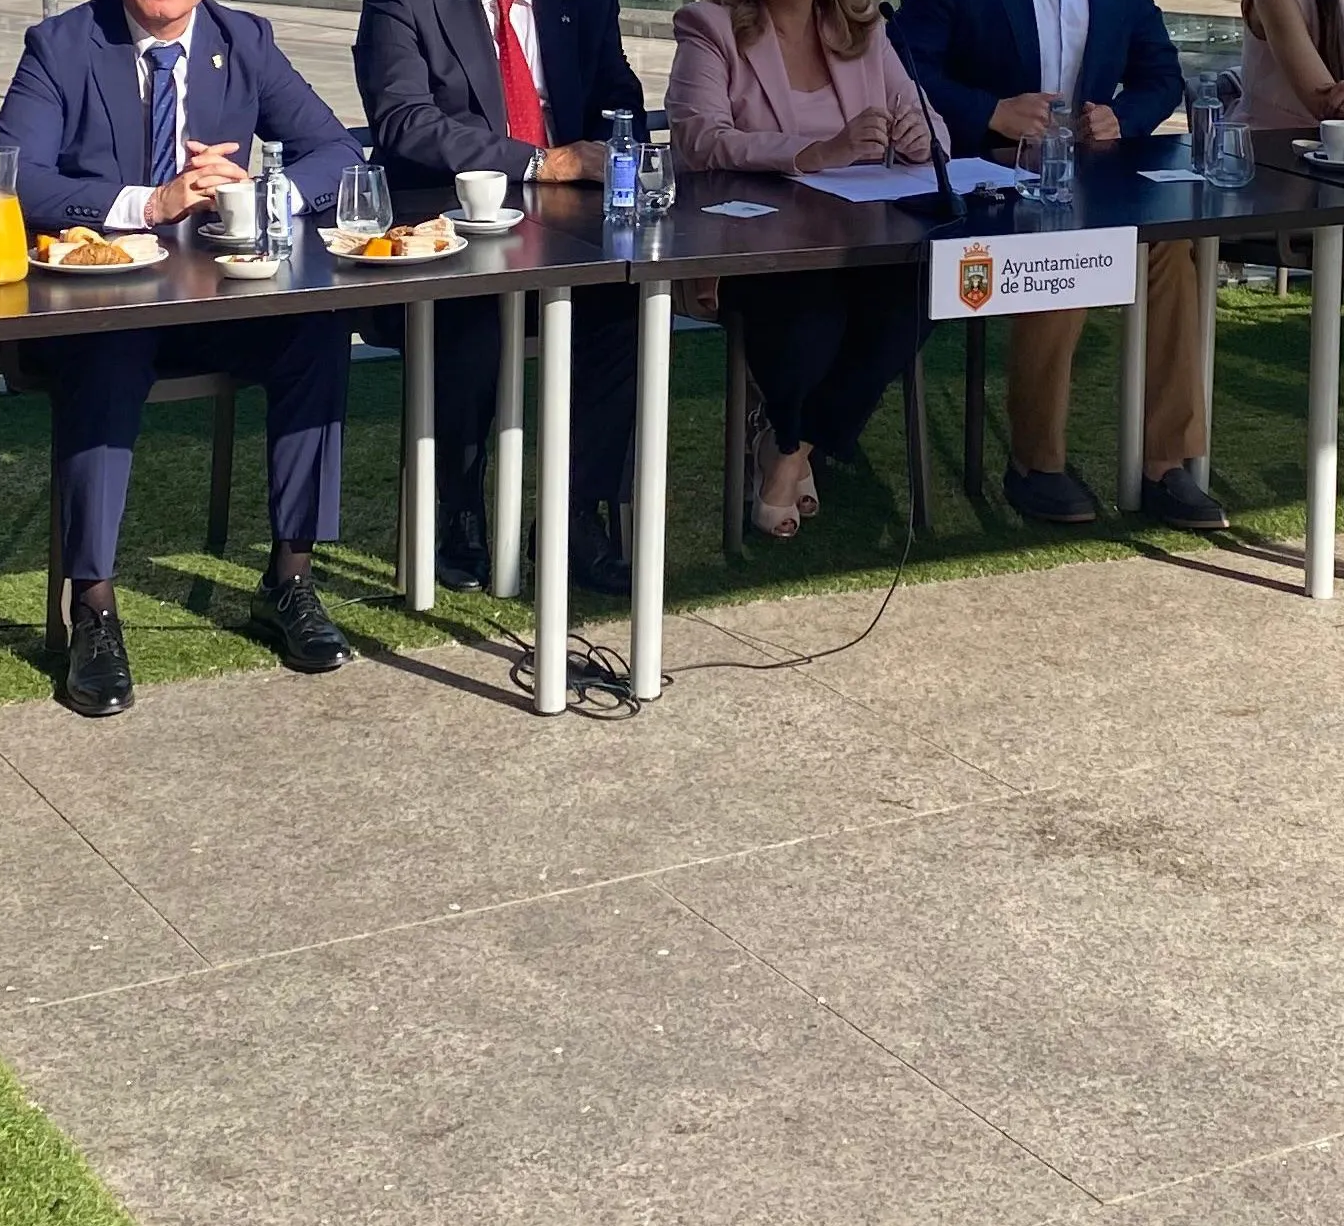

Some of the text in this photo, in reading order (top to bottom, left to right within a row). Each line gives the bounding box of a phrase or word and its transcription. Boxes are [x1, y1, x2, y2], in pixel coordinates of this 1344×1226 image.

[1001, 253, 1113, 277] Ayuntamiento
[1001, 276, 1075, 294] de Burgos
